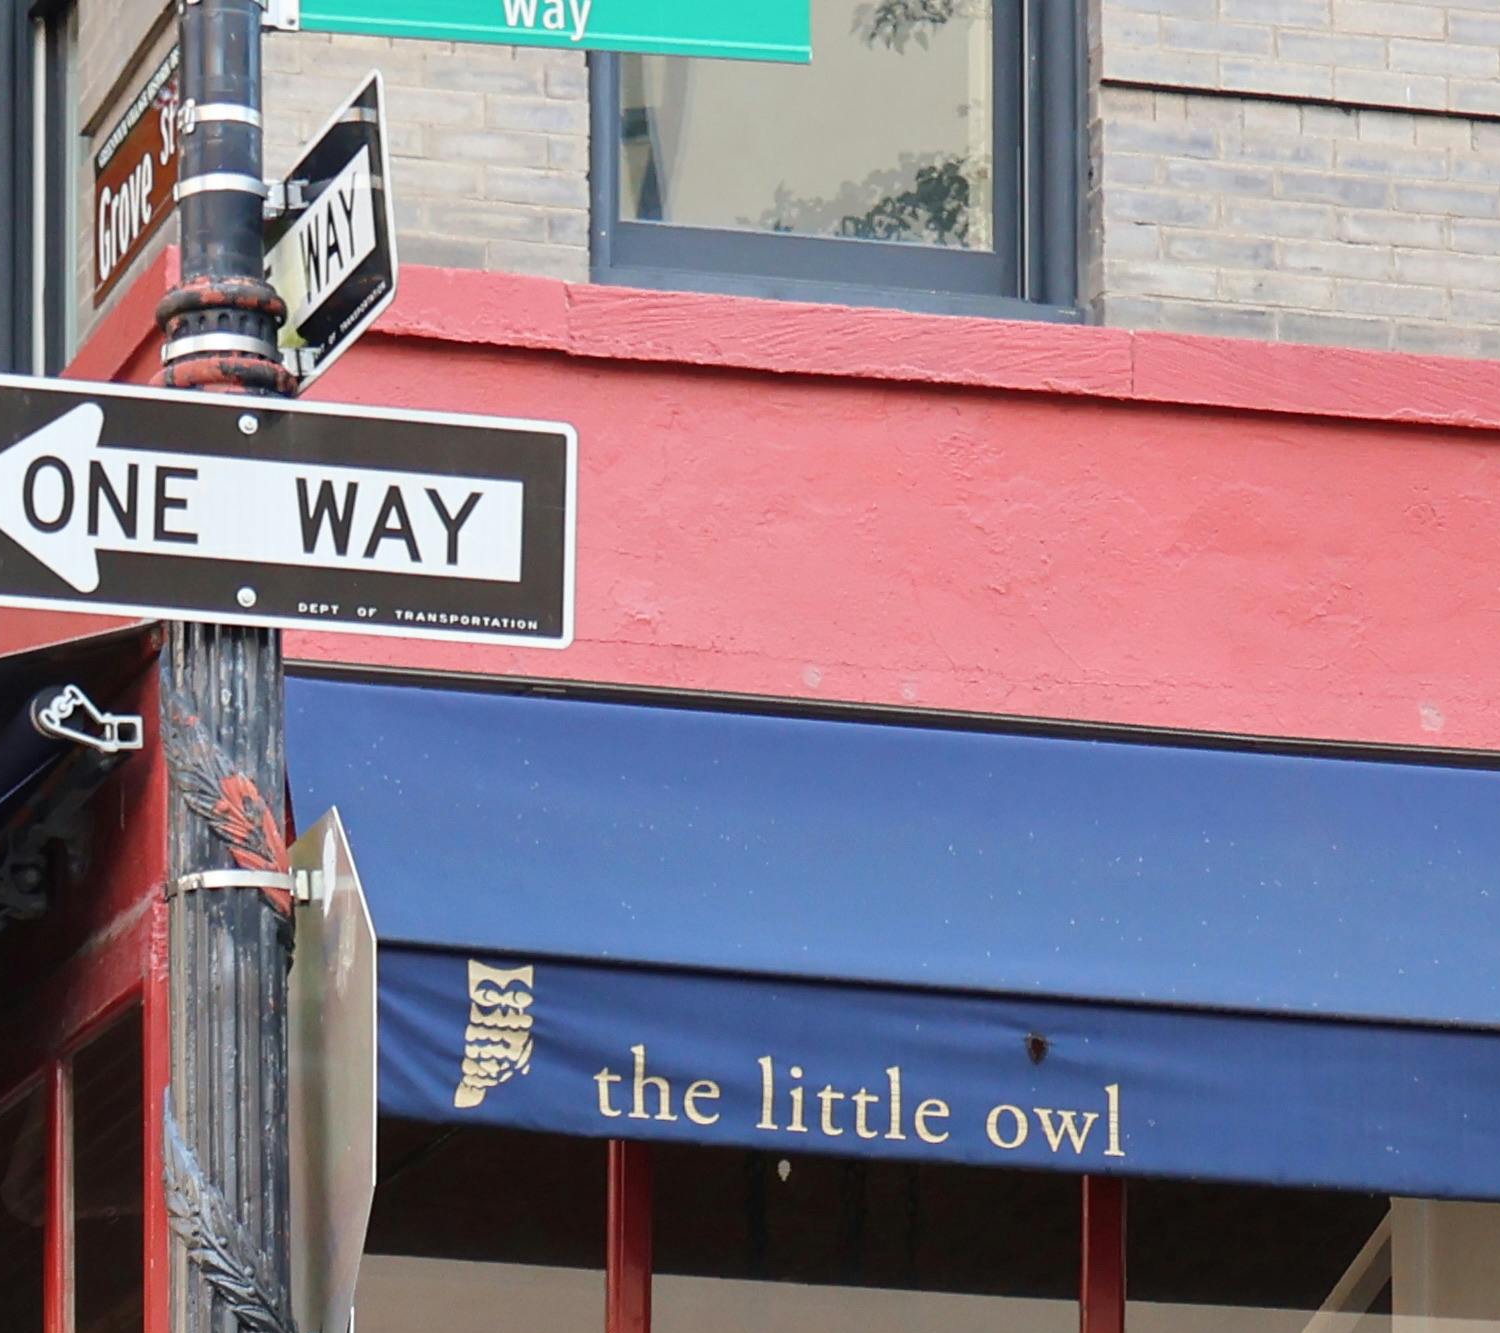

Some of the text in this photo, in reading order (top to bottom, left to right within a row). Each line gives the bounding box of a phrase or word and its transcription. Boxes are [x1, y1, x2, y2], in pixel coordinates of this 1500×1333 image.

[99, 152, 152, 282] Grove
[160, 100, 176, 166] St
[299, 171, 358, 304] WAY
[22, 455, 484, 566] ONE WAY
[298, 603, 538, 630] DEPT OF TRANSPORTATION
[593, 1045, 1126, 1156] the little owl
